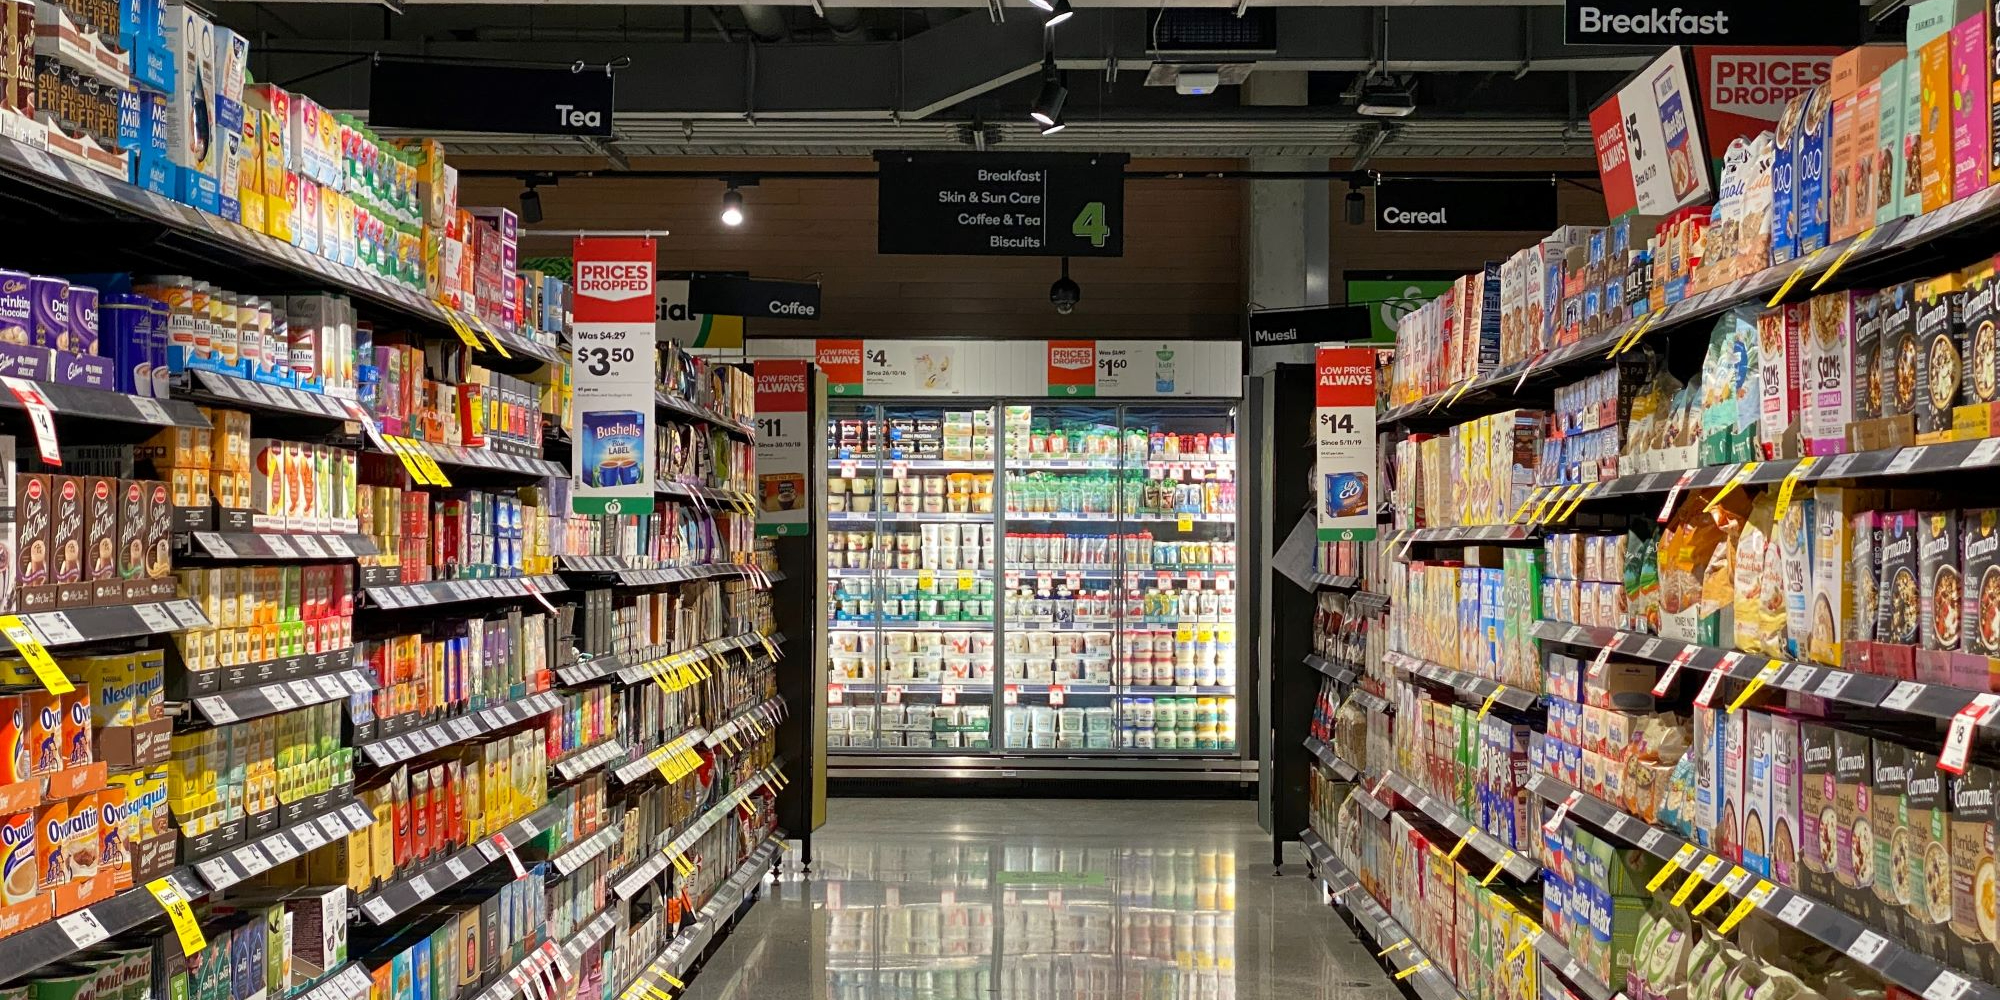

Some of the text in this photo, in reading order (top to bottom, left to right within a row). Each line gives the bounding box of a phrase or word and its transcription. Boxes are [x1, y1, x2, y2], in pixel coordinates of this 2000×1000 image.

[1580, 7, 1729, 35] Breakfast
[1716, 62, 1831, 86] PRICES
[555, 104, 601, 127] Tea
[1607, 122, 1622, 145] PRICE
[1625, 112, 1643, 161] $5
[1601, 141, 1626, 174] ALWAYS
[978, 169, 1041, 182] Breakfast
[938, 190, 1041, 205] Skin & Sun Care
[957, 213, 1041, 226] Coffee & Tea
[1072, 201, 1111, 248] 4
[1383, 206, 1448, 225] Cereal
[990, 235, 1041, 248] Biscuits
[581, 265, 648, 280] PRICES
[581, 280, 648, 291] DROPPED
[768, 300, 815, 316] Coffee
[1915, 296, 1948, 335] Carman's
[578, 331, 626, 340] Was $4.29
[1255, 327, 1297, 343] Muesli
[818, 355, 861, 365] ALWAYS
[819, 348, 860, 356] LOW PRICE
[866, 349, 888, 368] $4
[1052, 350, 1091, 359] PRICES
[757, 374, 805, 383] LOW PRICE
[1320, 366, 1372, 375] LOW PRICE
[756, 382, 806, 393] ALWAYS
[1319, 375, 1373, 386] ALWAYS
[596, 423, 641, 440] Bushells
[757, 418, 782, 437] $11
[1320, 413, 1354, 434] $14
[608, 446, 630, 455] LABEL
[758, 441, 774, 449] Since
[32, 513, 48, 537] Choc
[66, 514, 81, 537] Choc
[100, 513, 114, 536] Choc
[132, 515, 145, 536] Choc
[157, 515, 171, 536] Choc
[1965, 528, 1998, 560] Carman's
[1803, 738, 1831, 763] Carman's
[1836, 747, 1865, 772] Carman's
[1906, 767, 1940, 797] Carman's
